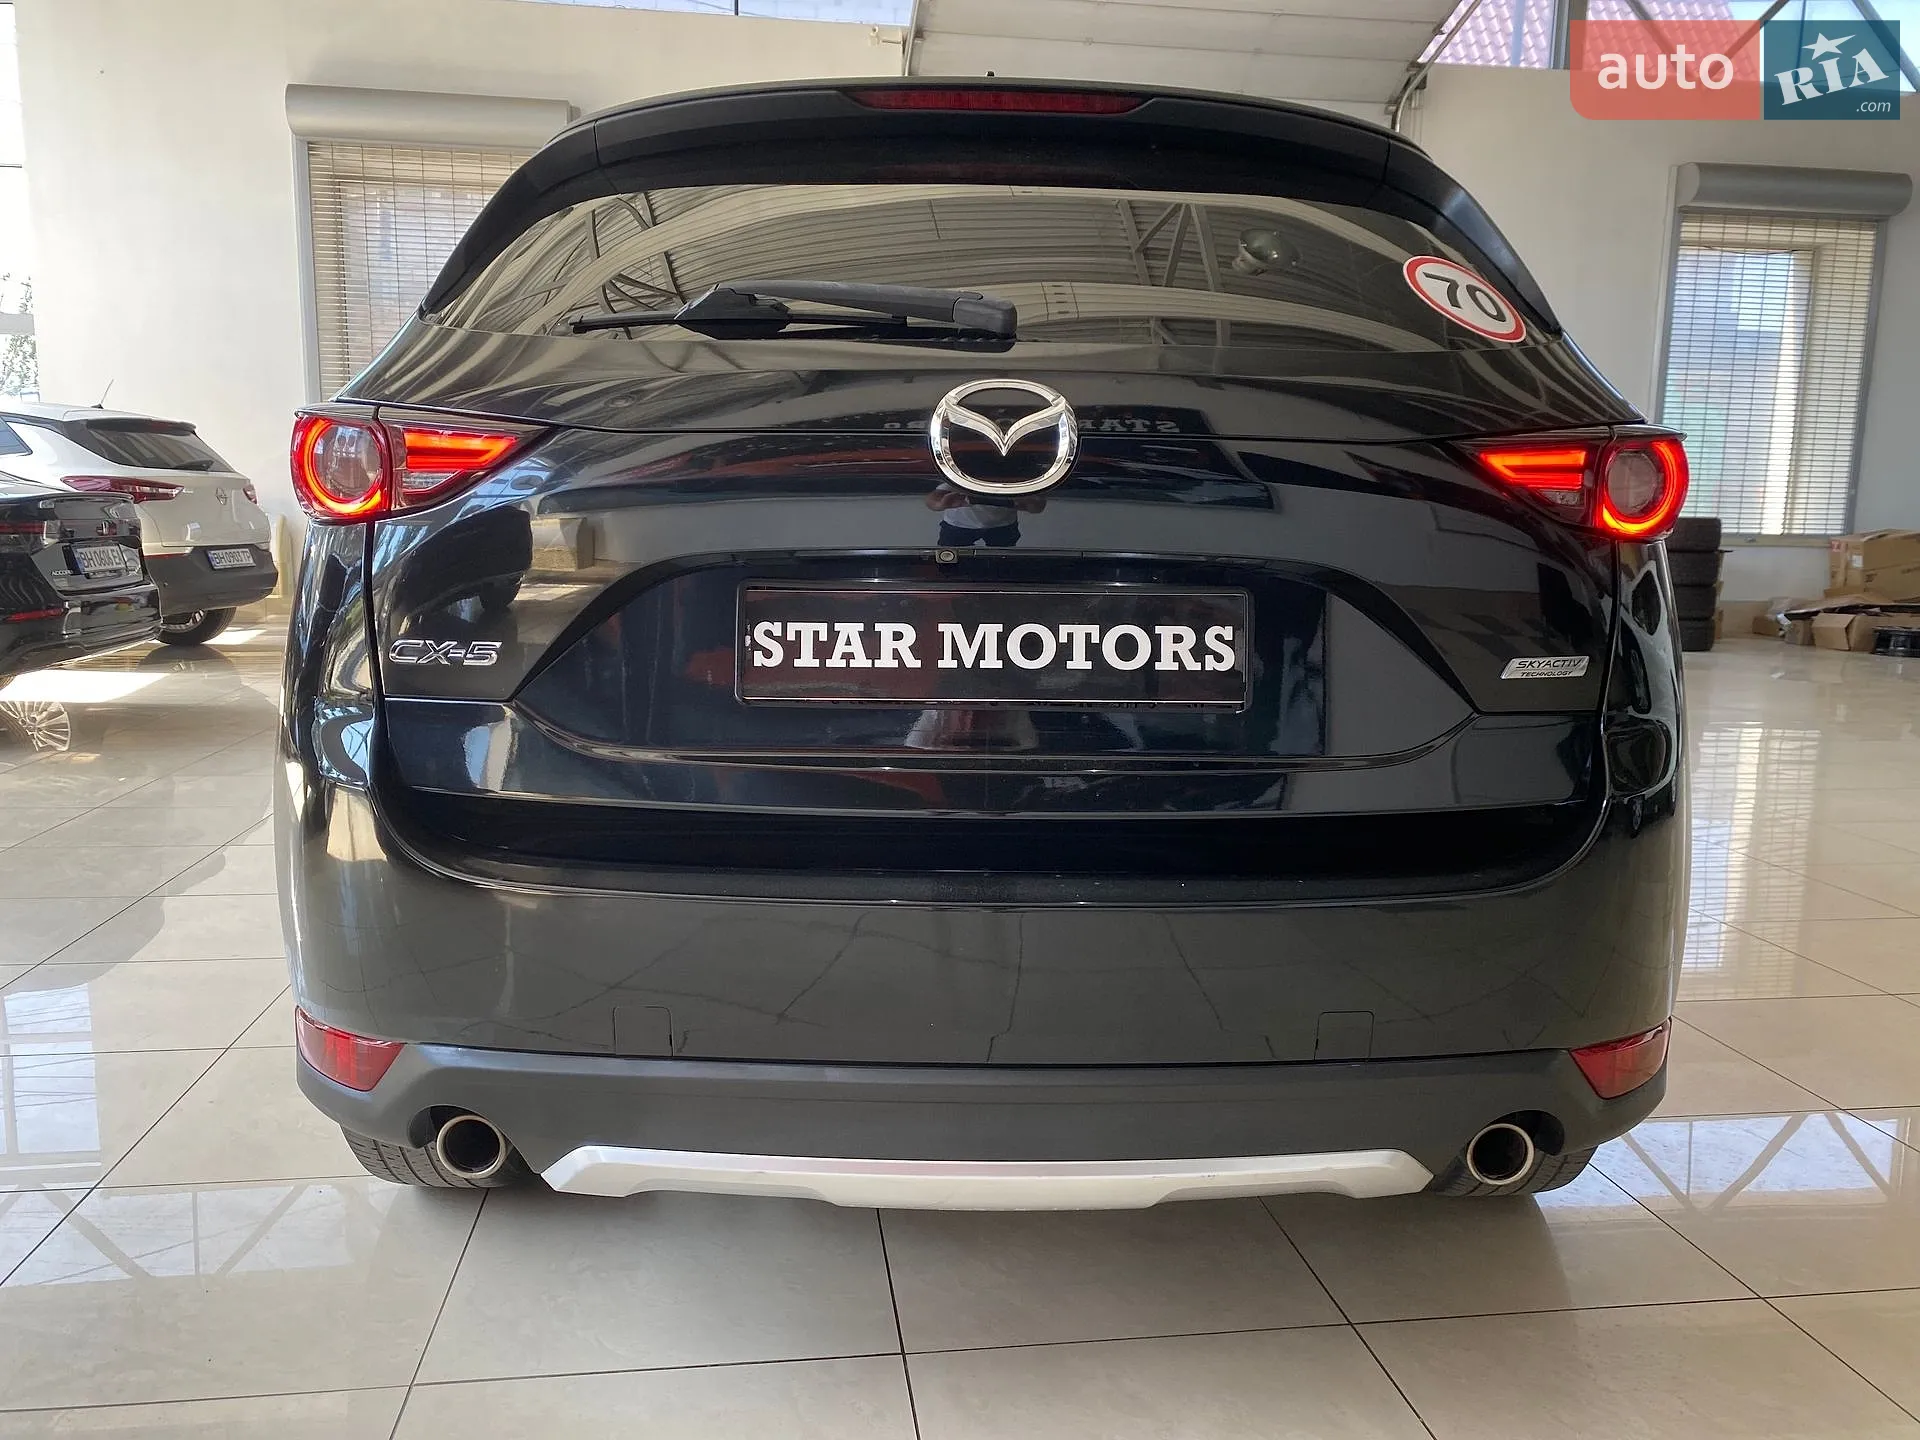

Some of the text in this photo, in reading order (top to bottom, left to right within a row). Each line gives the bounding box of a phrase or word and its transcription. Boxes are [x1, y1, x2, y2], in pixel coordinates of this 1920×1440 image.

[1422, 271, 1507, 322] 70
[388, 639, 503, 666] CX-5
[752, 620, 1236, 672] STAR MOTORS
[1516, 658, 1582, 669] SKYACTIV
